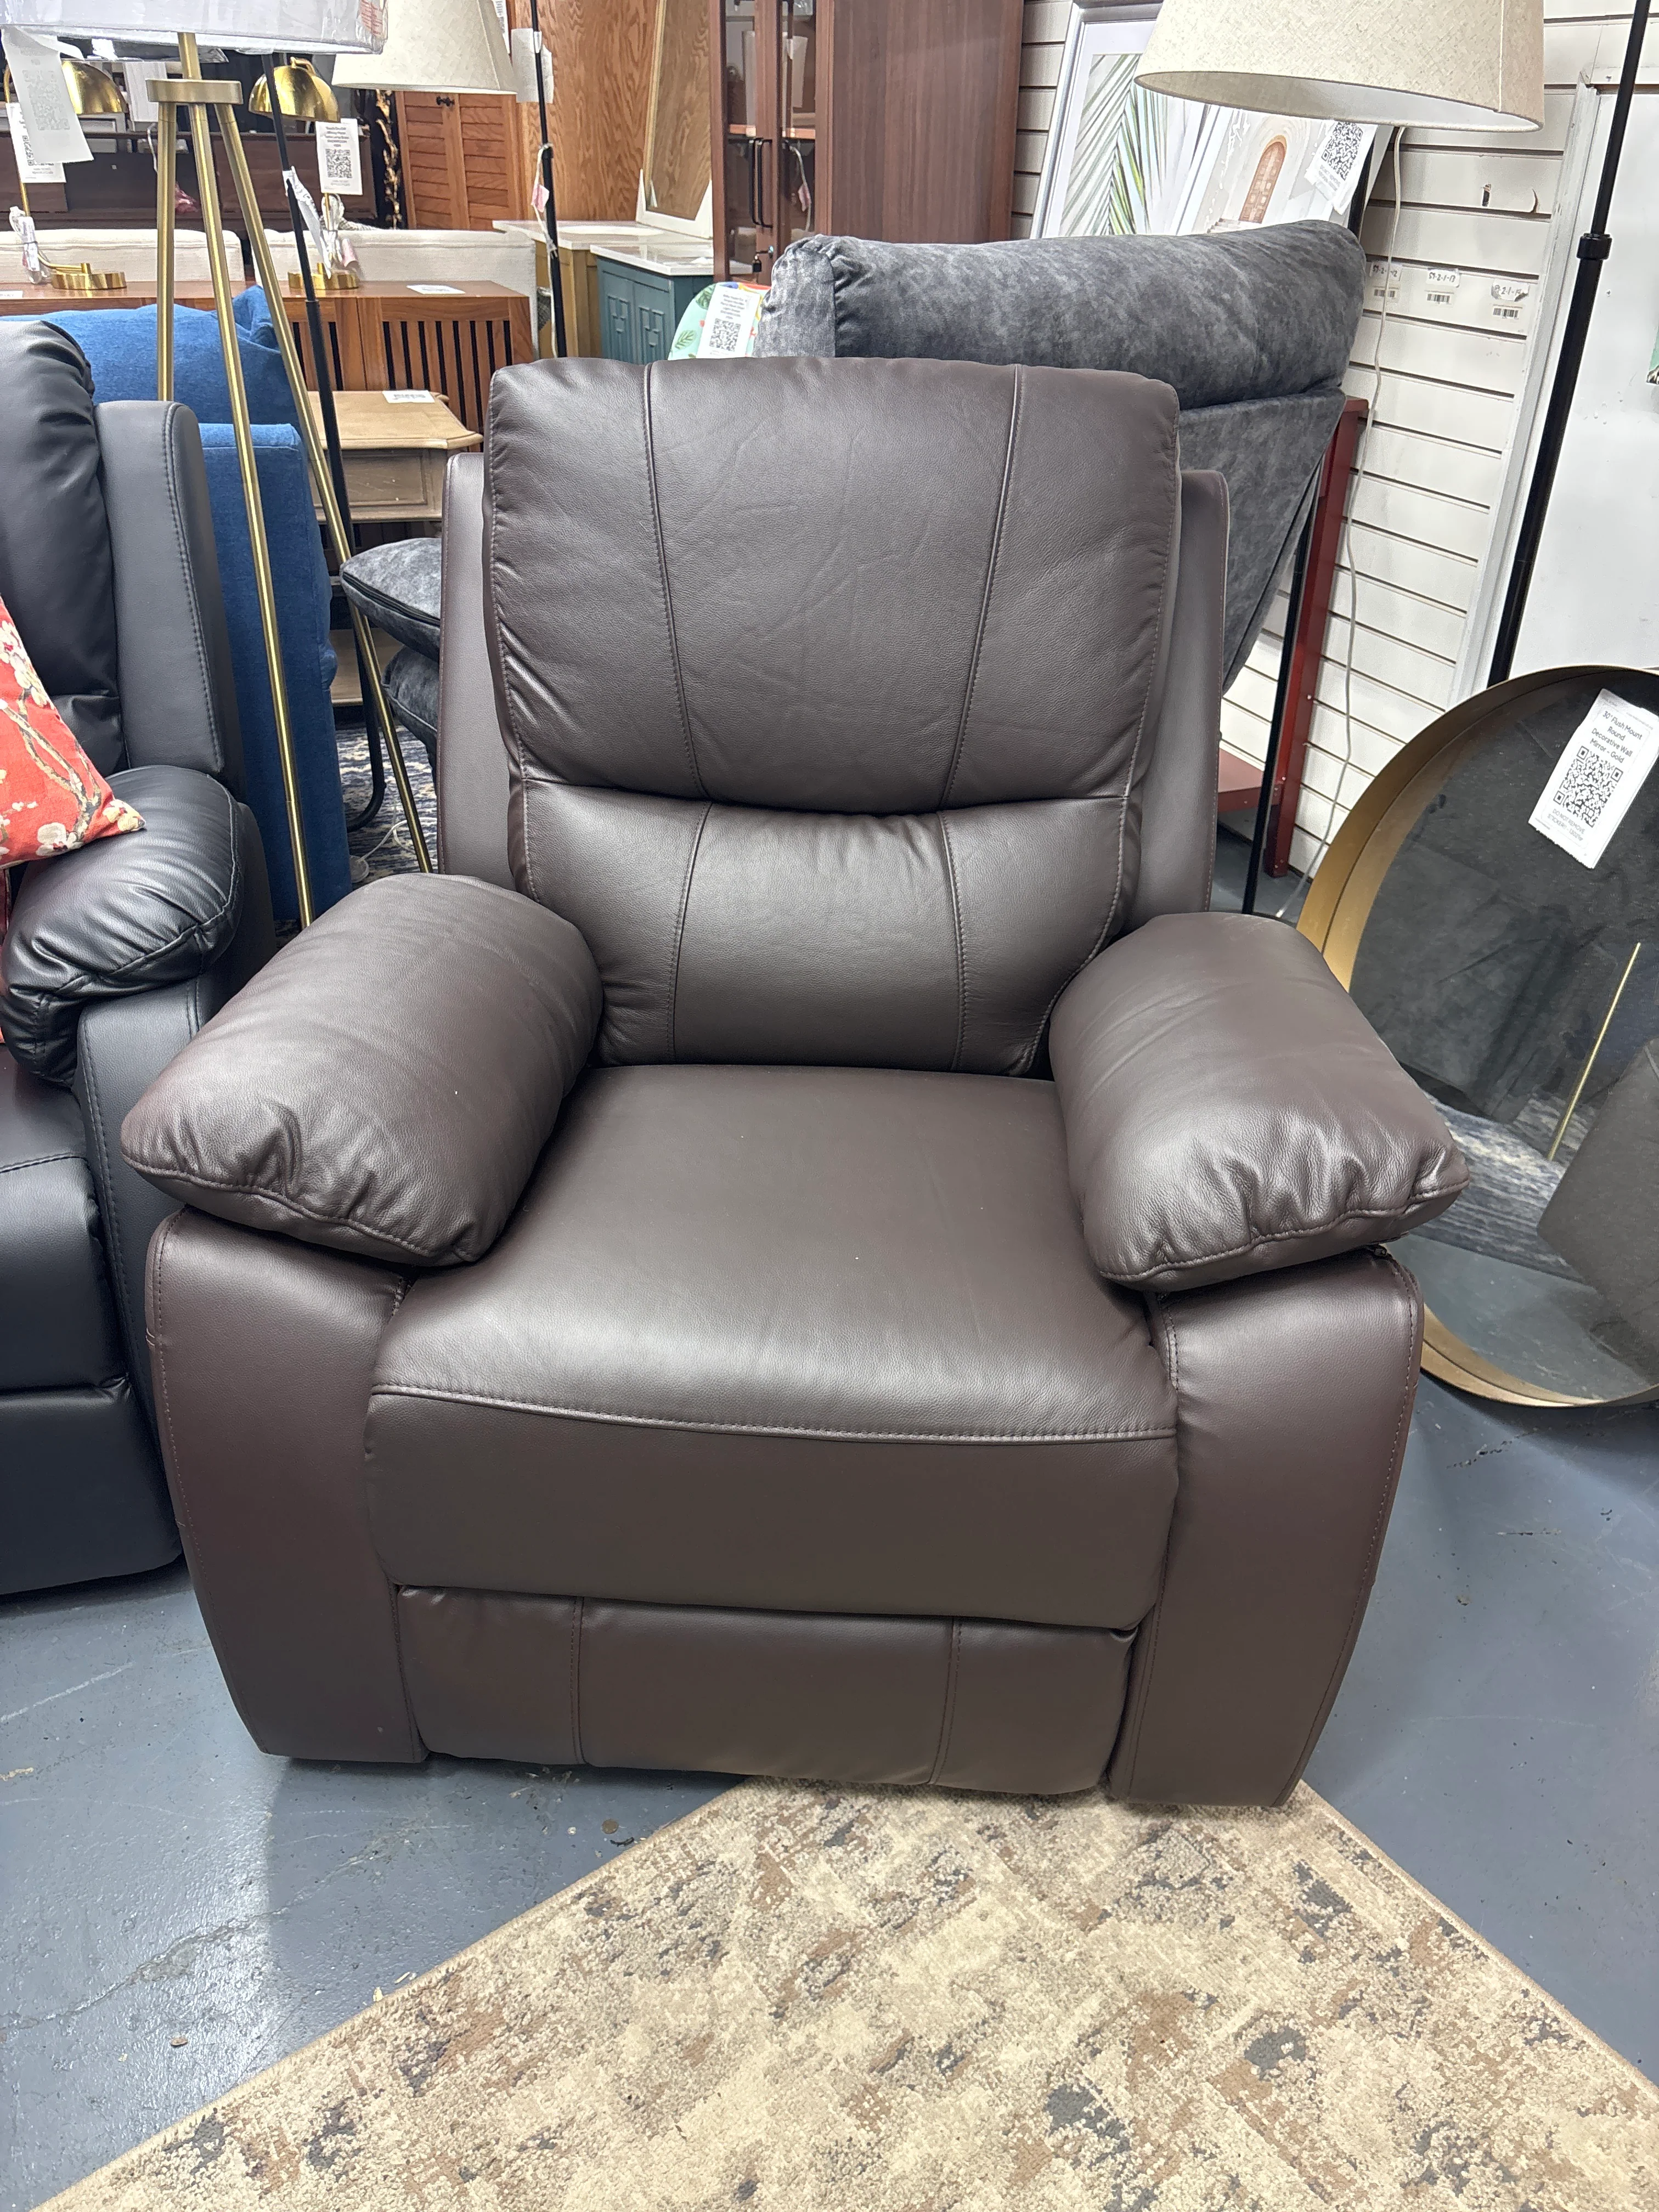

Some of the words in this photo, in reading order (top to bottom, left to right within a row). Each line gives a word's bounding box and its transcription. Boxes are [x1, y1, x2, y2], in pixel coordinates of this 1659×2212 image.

[1607, 726, 1626, 741] Round
[1611, 716, 1625, 729] Flush
[1624, 725, 1643, 740] Mount
[1589, 738, 1607, 752] Mirror
[1610, 751, 1625, 764] Gold
[1591, 727, 1621, 750] Decorative
[1620, 745, 1633, 757] Wall
[1568, 819, 1585, 834] REMOVE
